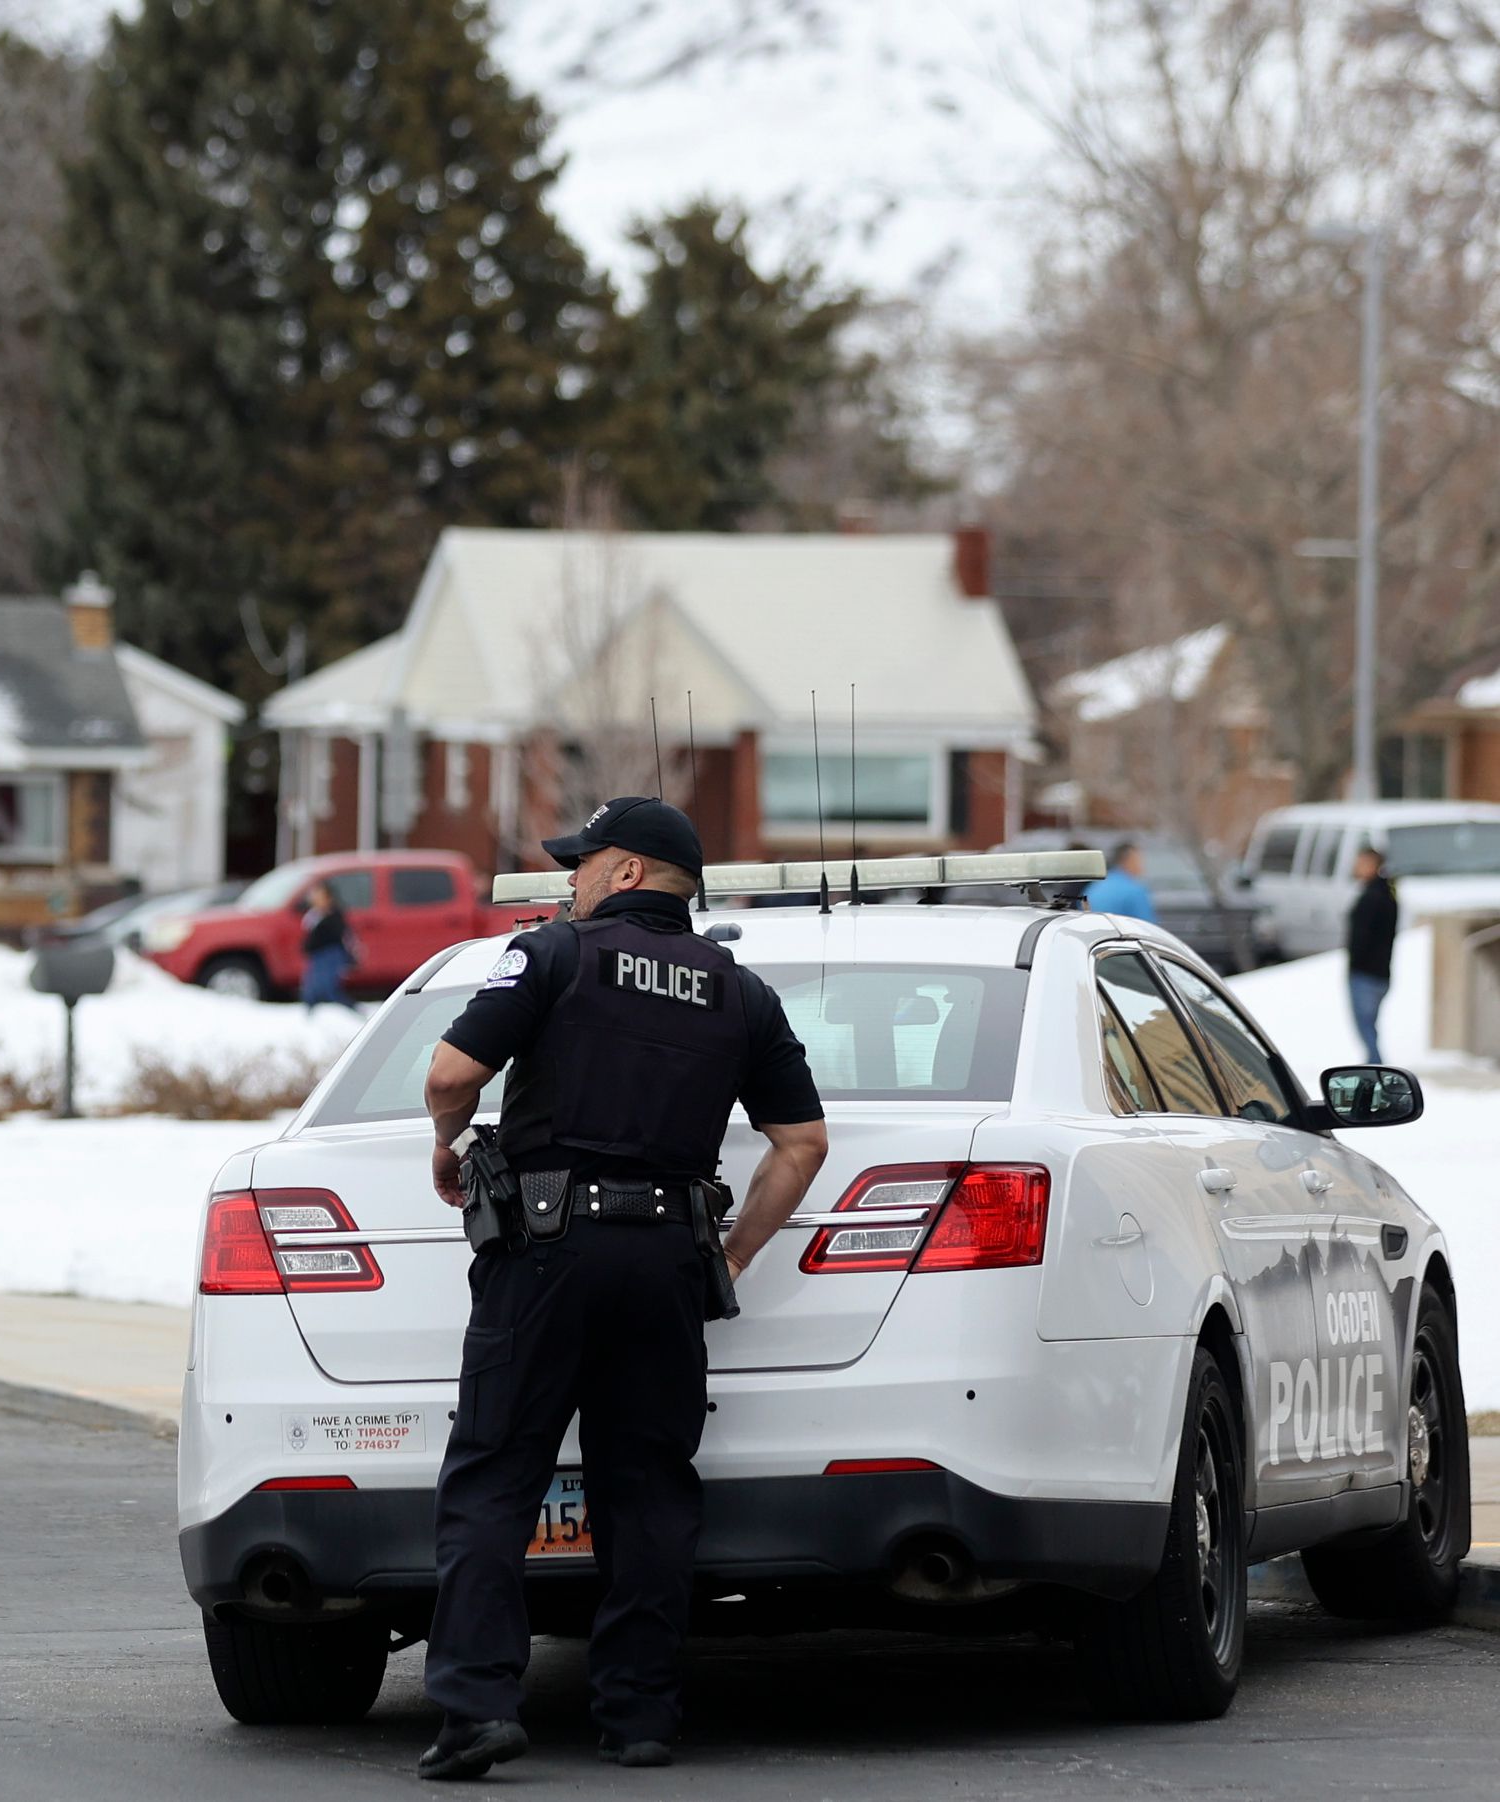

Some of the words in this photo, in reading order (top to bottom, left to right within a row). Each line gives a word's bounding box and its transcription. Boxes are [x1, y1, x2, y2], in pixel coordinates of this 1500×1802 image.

[617, 951, 708, 1006] POLICE
[1326, 1291, 1381, 1346] OGDEN
[312, 1416, 340, 1427] HAVE
[344, 1416, 352, 1426] A
[355, 1415, 391, 1426] CRIME
[395, 1414, 420, 1425] TIP?
[1269, 1354, 1385, 1466] POLICE
[325, 1428, 353, 1438] TEXT:
[357, 1427, 410, 1438] TIPACOP
[334, 1440, 351, 1450] TO:
[355, 1439, 401, 1450] 274637
